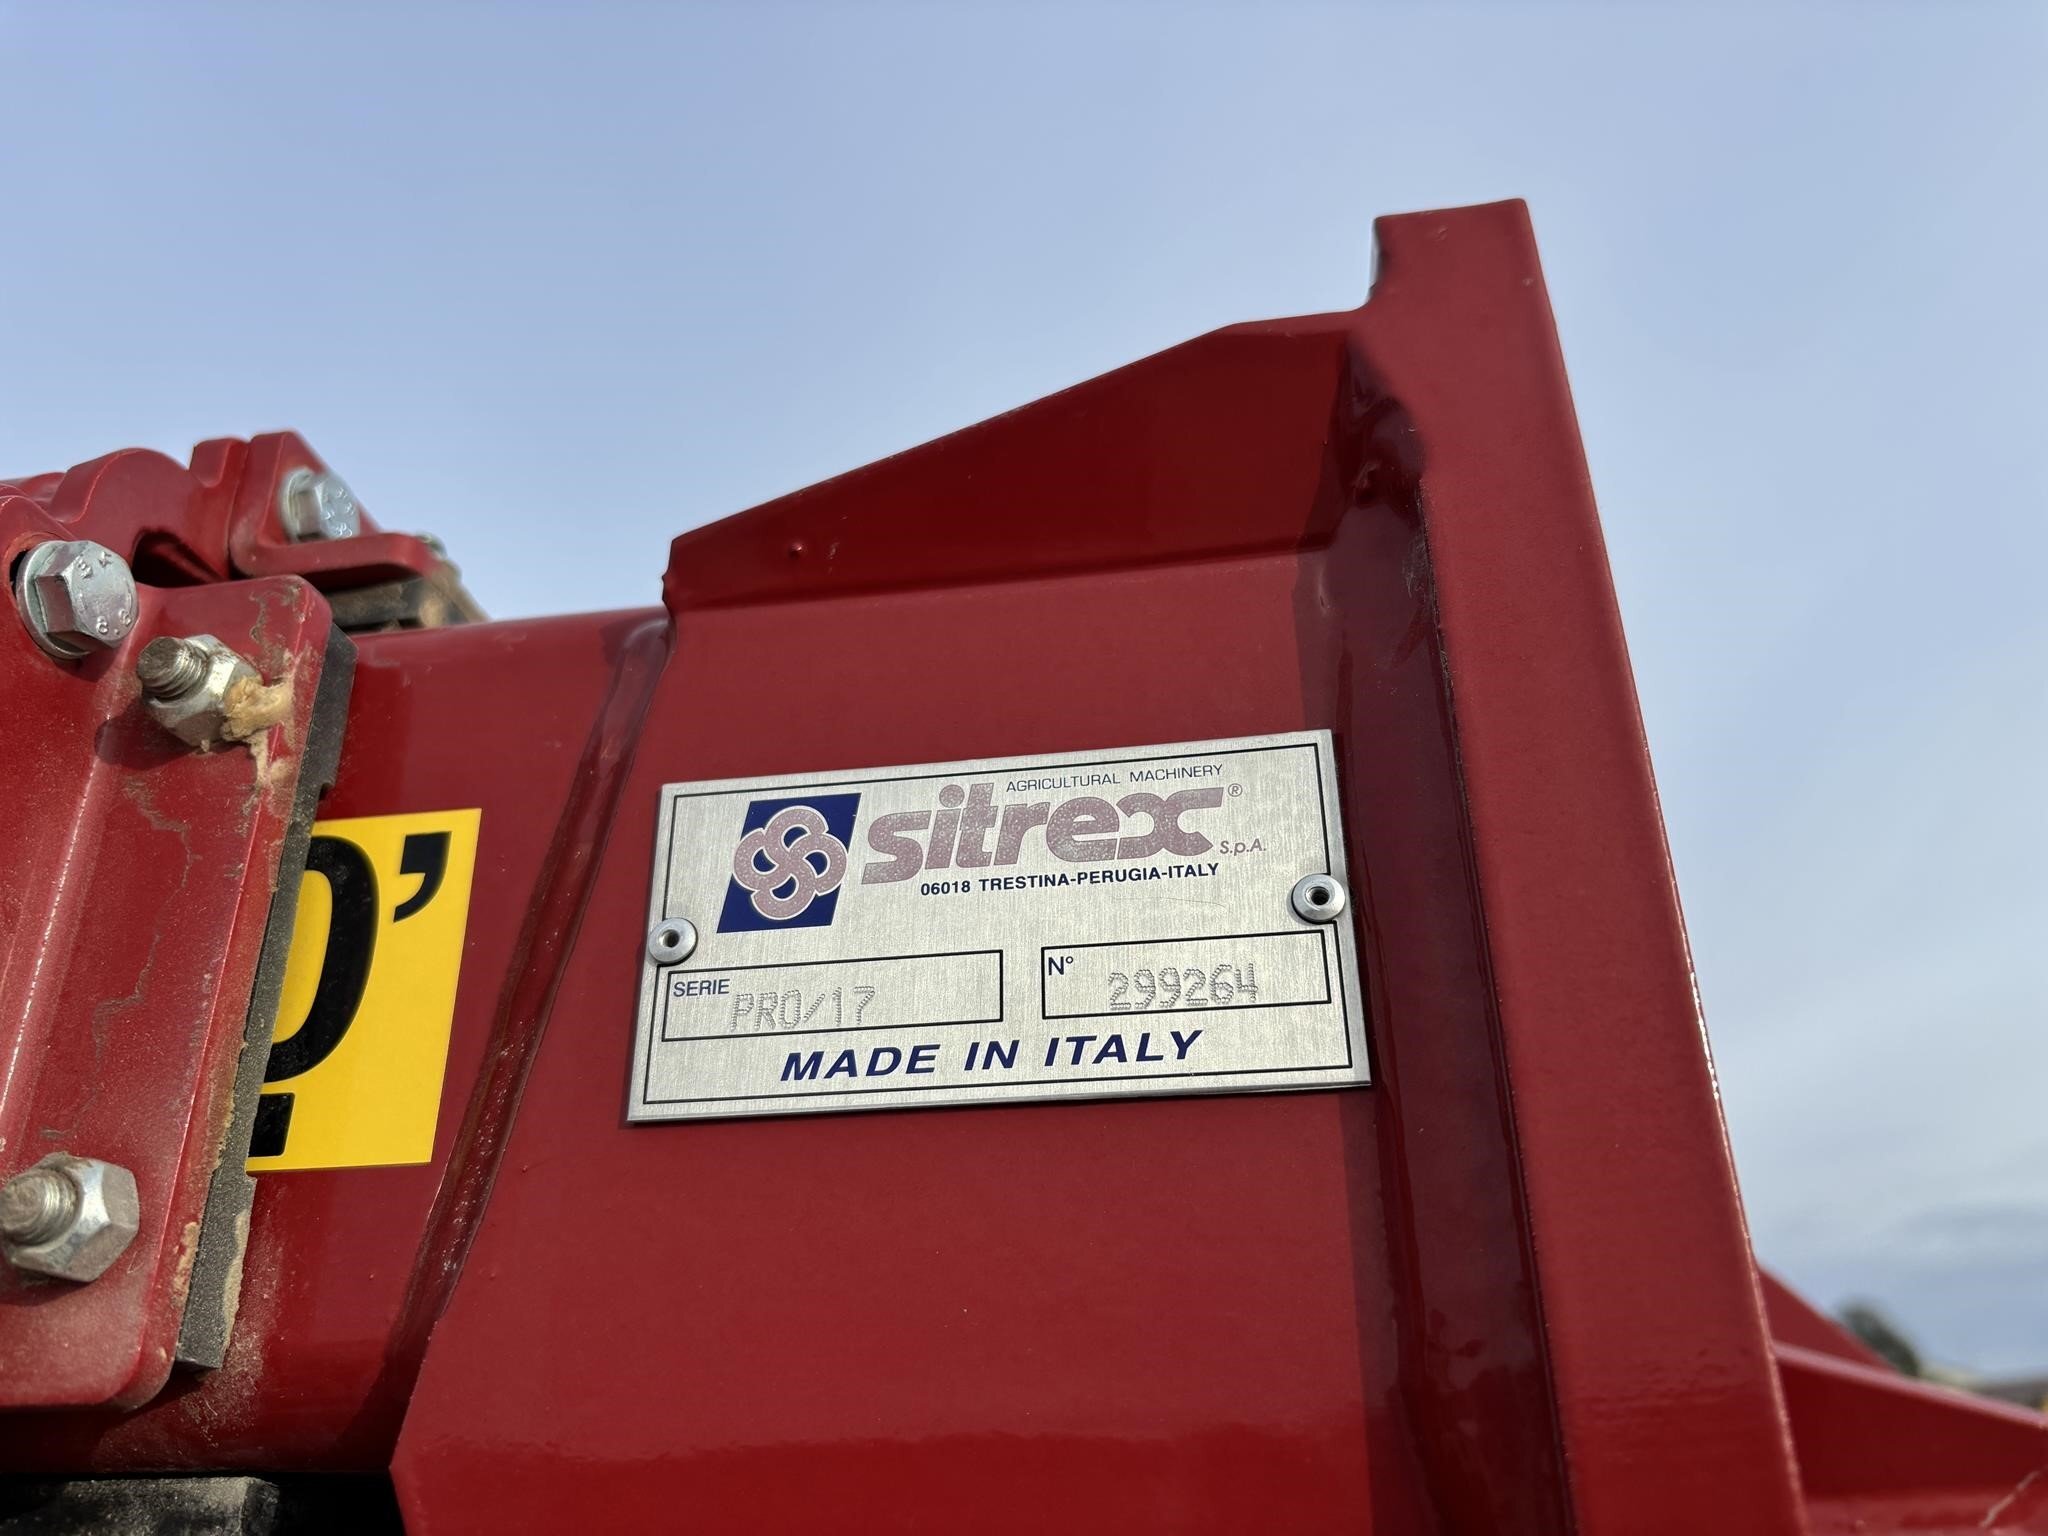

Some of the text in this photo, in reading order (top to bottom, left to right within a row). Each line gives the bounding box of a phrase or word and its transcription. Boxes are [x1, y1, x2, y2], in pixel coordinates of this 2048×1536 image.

[1006, 764, 1224, 793] AGRICULTURAL MACHINERY
[1219, 838, 1267, 856] S.p.A.
[920, 863, 1219, 896] 06018 TRESTINA-PERUGIA-ITALY
[1048, 956, 1074, 976] N°
[673, 979, 730, 997] SERIE
[1107, 963, 1258, 1010] 299264
[780, 1030, 1204, 1082] MADE IN ITALY
